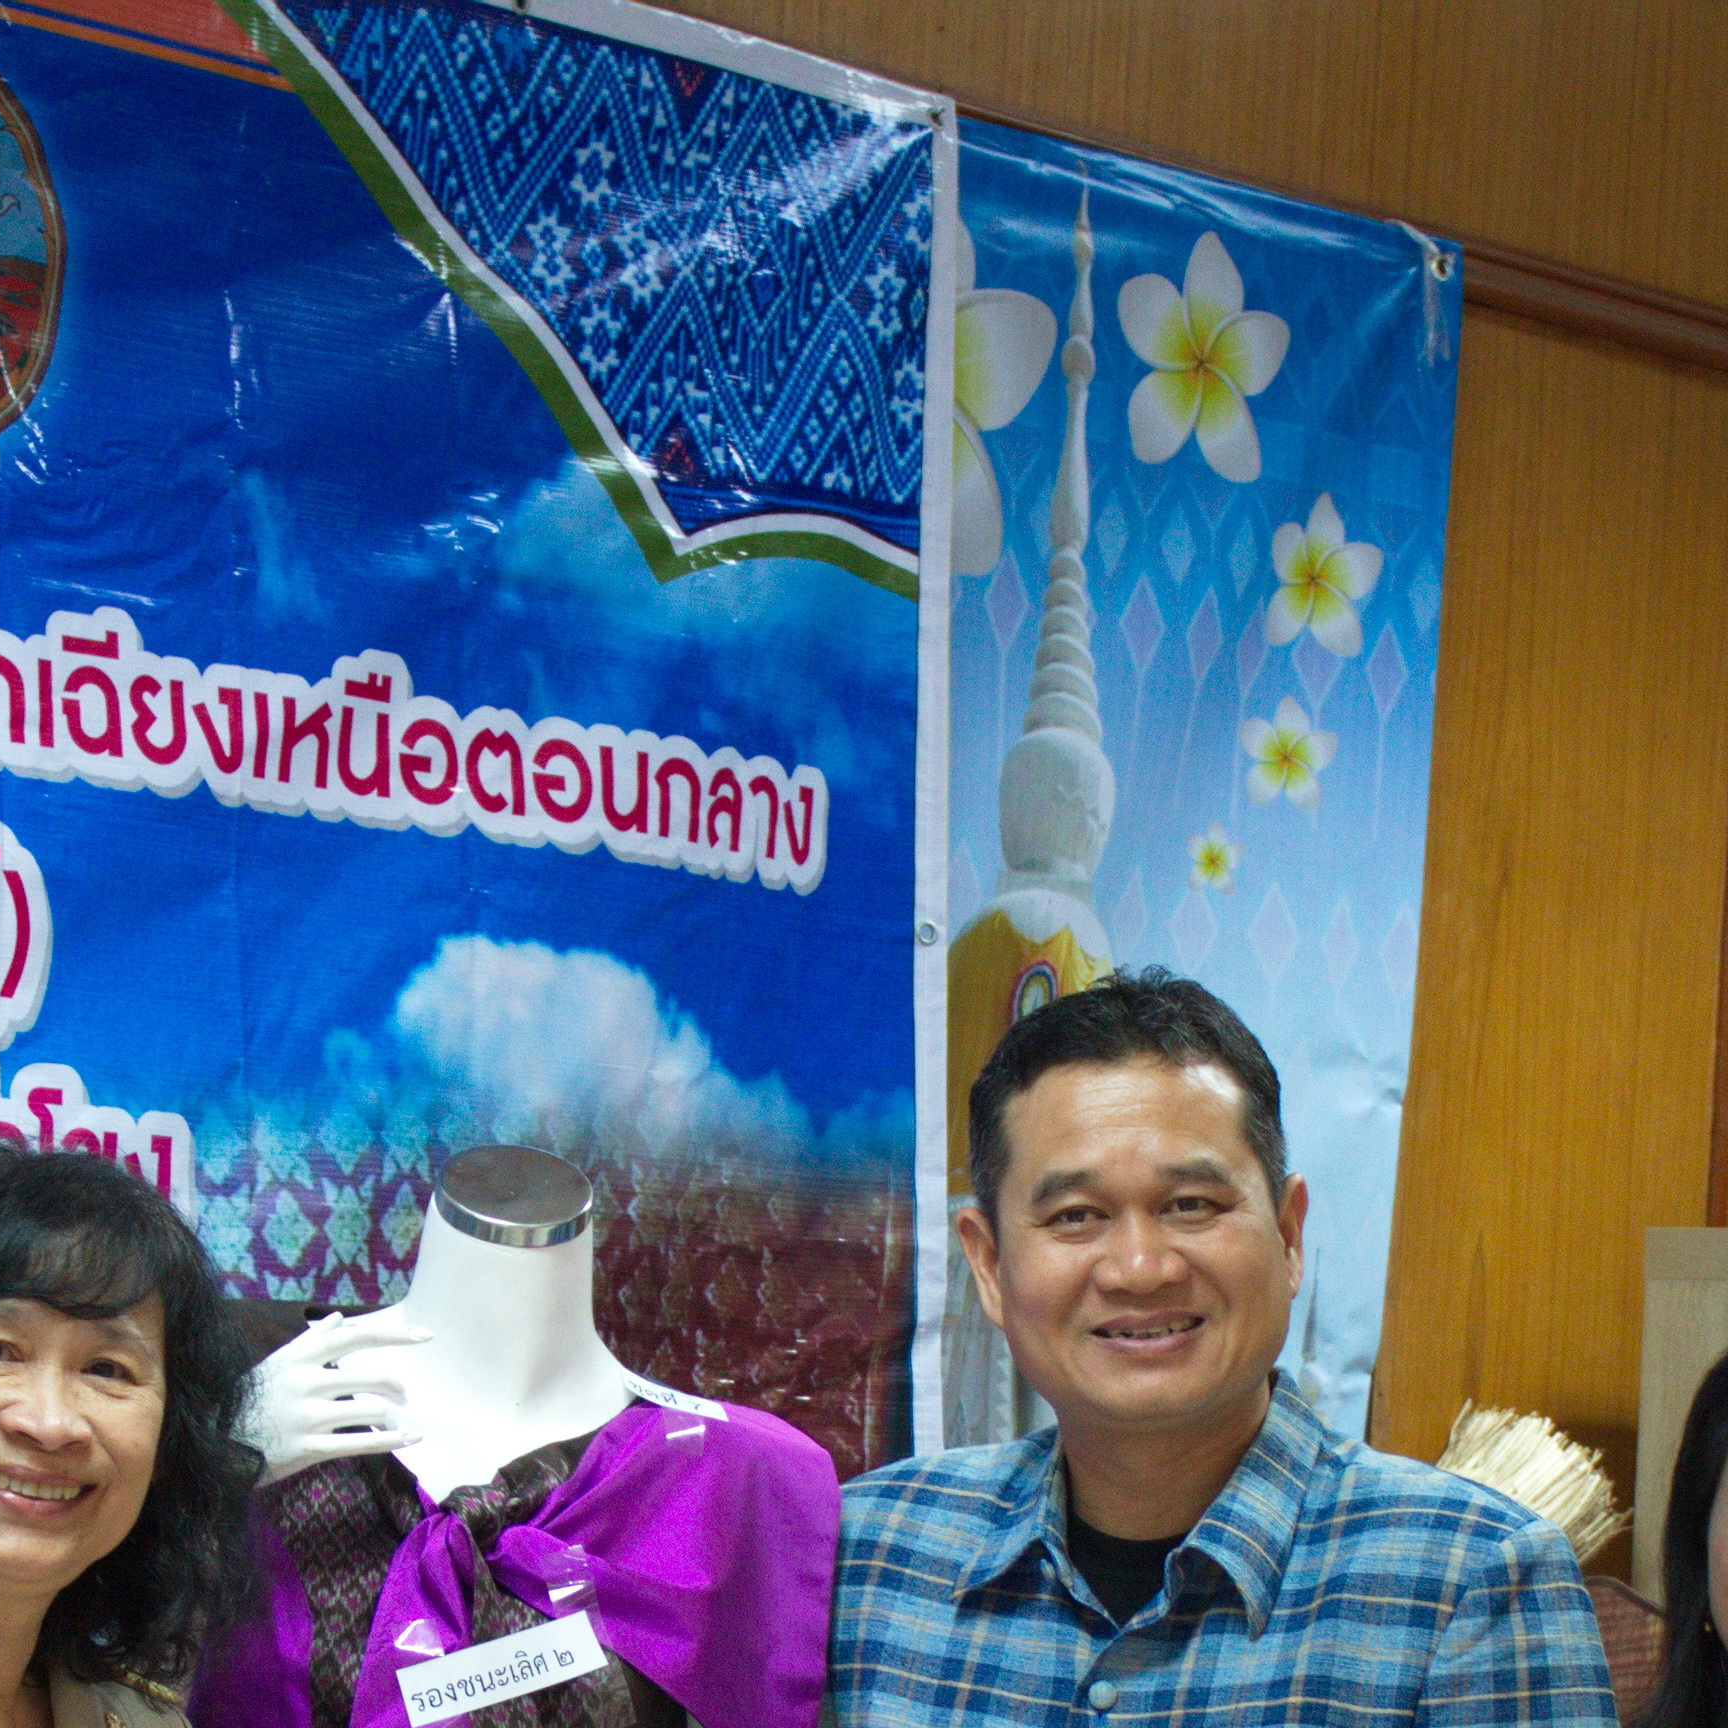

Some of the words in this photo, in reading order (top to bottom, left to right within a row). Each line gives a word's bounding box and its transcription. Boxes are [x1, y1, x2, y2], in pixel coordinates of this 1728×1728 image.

[411, 1650, 550, 1712] รองชนะเลิศ
[553, 1648, 575, 1667] ๒
